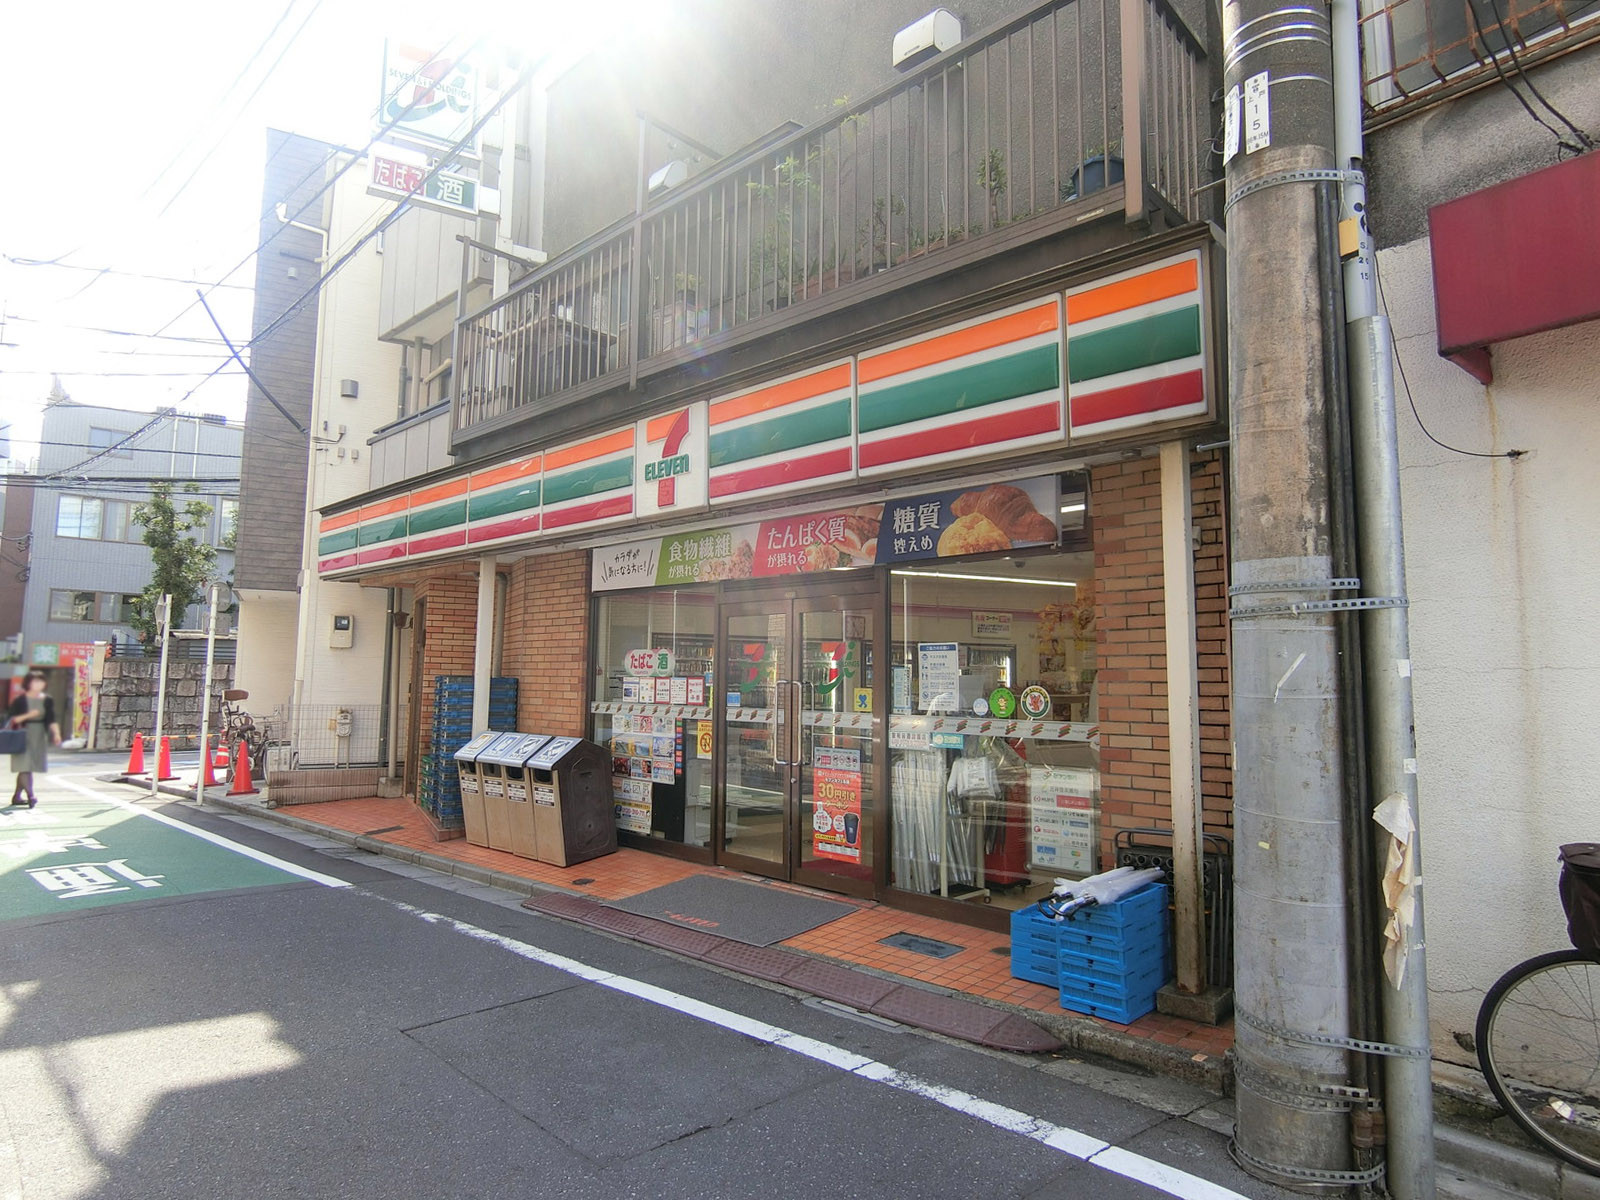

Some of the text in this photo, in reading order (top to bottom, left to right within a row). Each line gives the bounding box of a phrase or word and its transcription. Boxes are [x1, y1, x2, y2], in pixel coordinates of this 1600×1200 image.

[437, 175, 465, 205] 酒
[893, 502, 941, 534] 糖質
[767, 516, 846, 549] たんぱく質
[668, 533, 732, 562] 食物繊維
[893, 538, 933, 554] 控えめ
[767, 551, 809, 568] が摂れる
[668, 563, 700, 579] が摂れる
[630, 652, 668, 670] たばこ 酒
[818, 782, 856, 803] 30円引き
